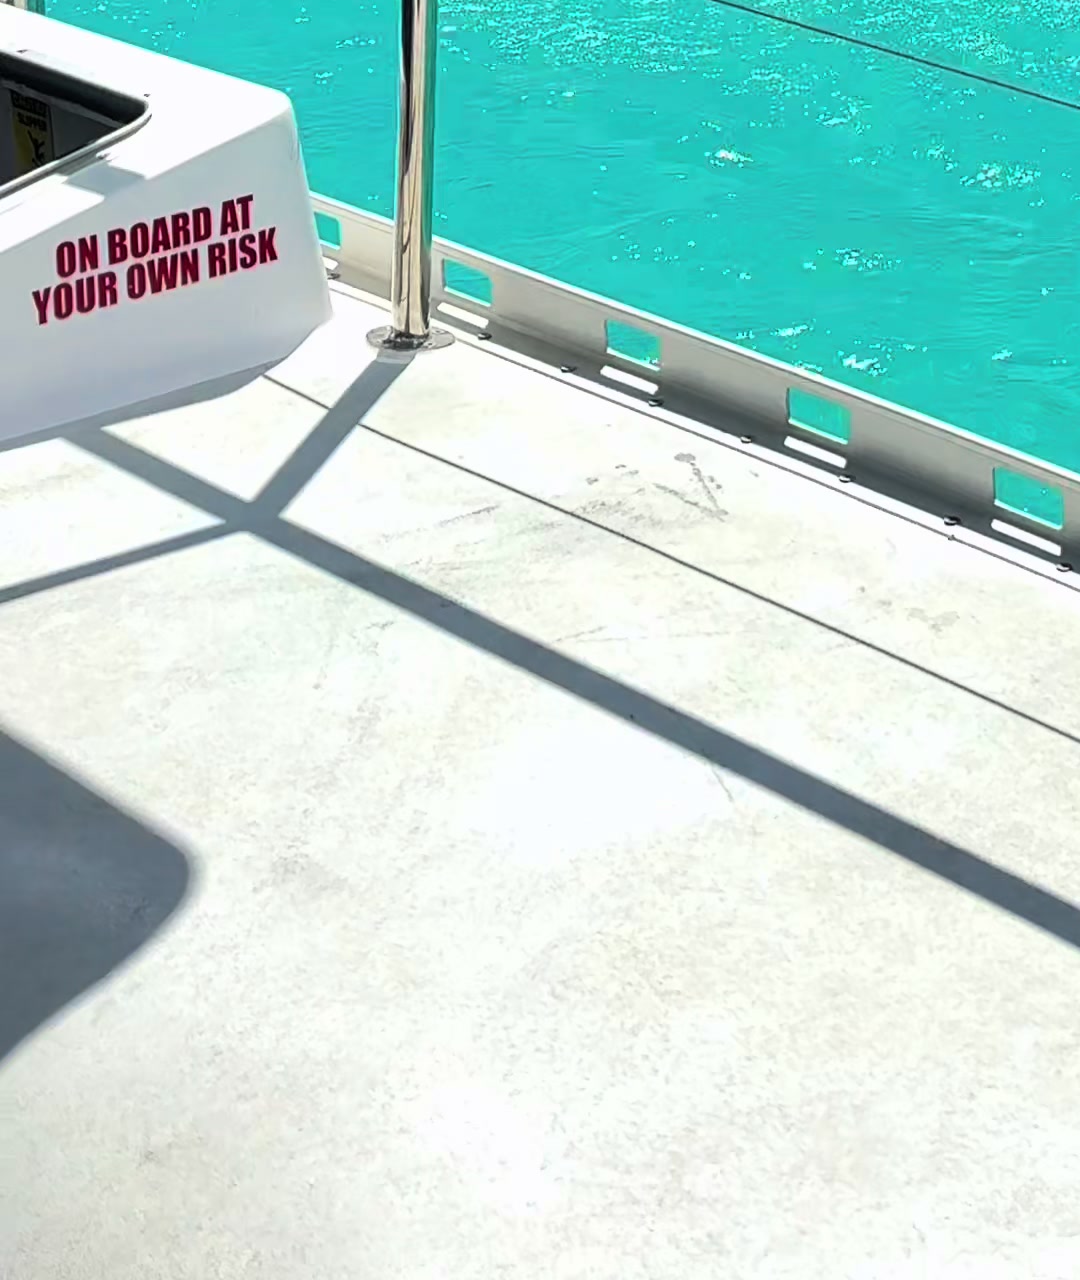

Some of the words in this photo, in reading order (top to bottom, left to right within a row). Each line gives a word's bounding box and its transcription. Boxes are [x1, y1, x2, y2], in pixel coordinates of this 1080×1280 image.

[32, 271, 117, 325] YOUR
[127, 249, 199, 300] OWN
[207, 227, 278, 279] RISK
[56, 235, 98, 277] ON
[107, 206, 212, 265] BOARD
[220, 194, 254, 235] AT
